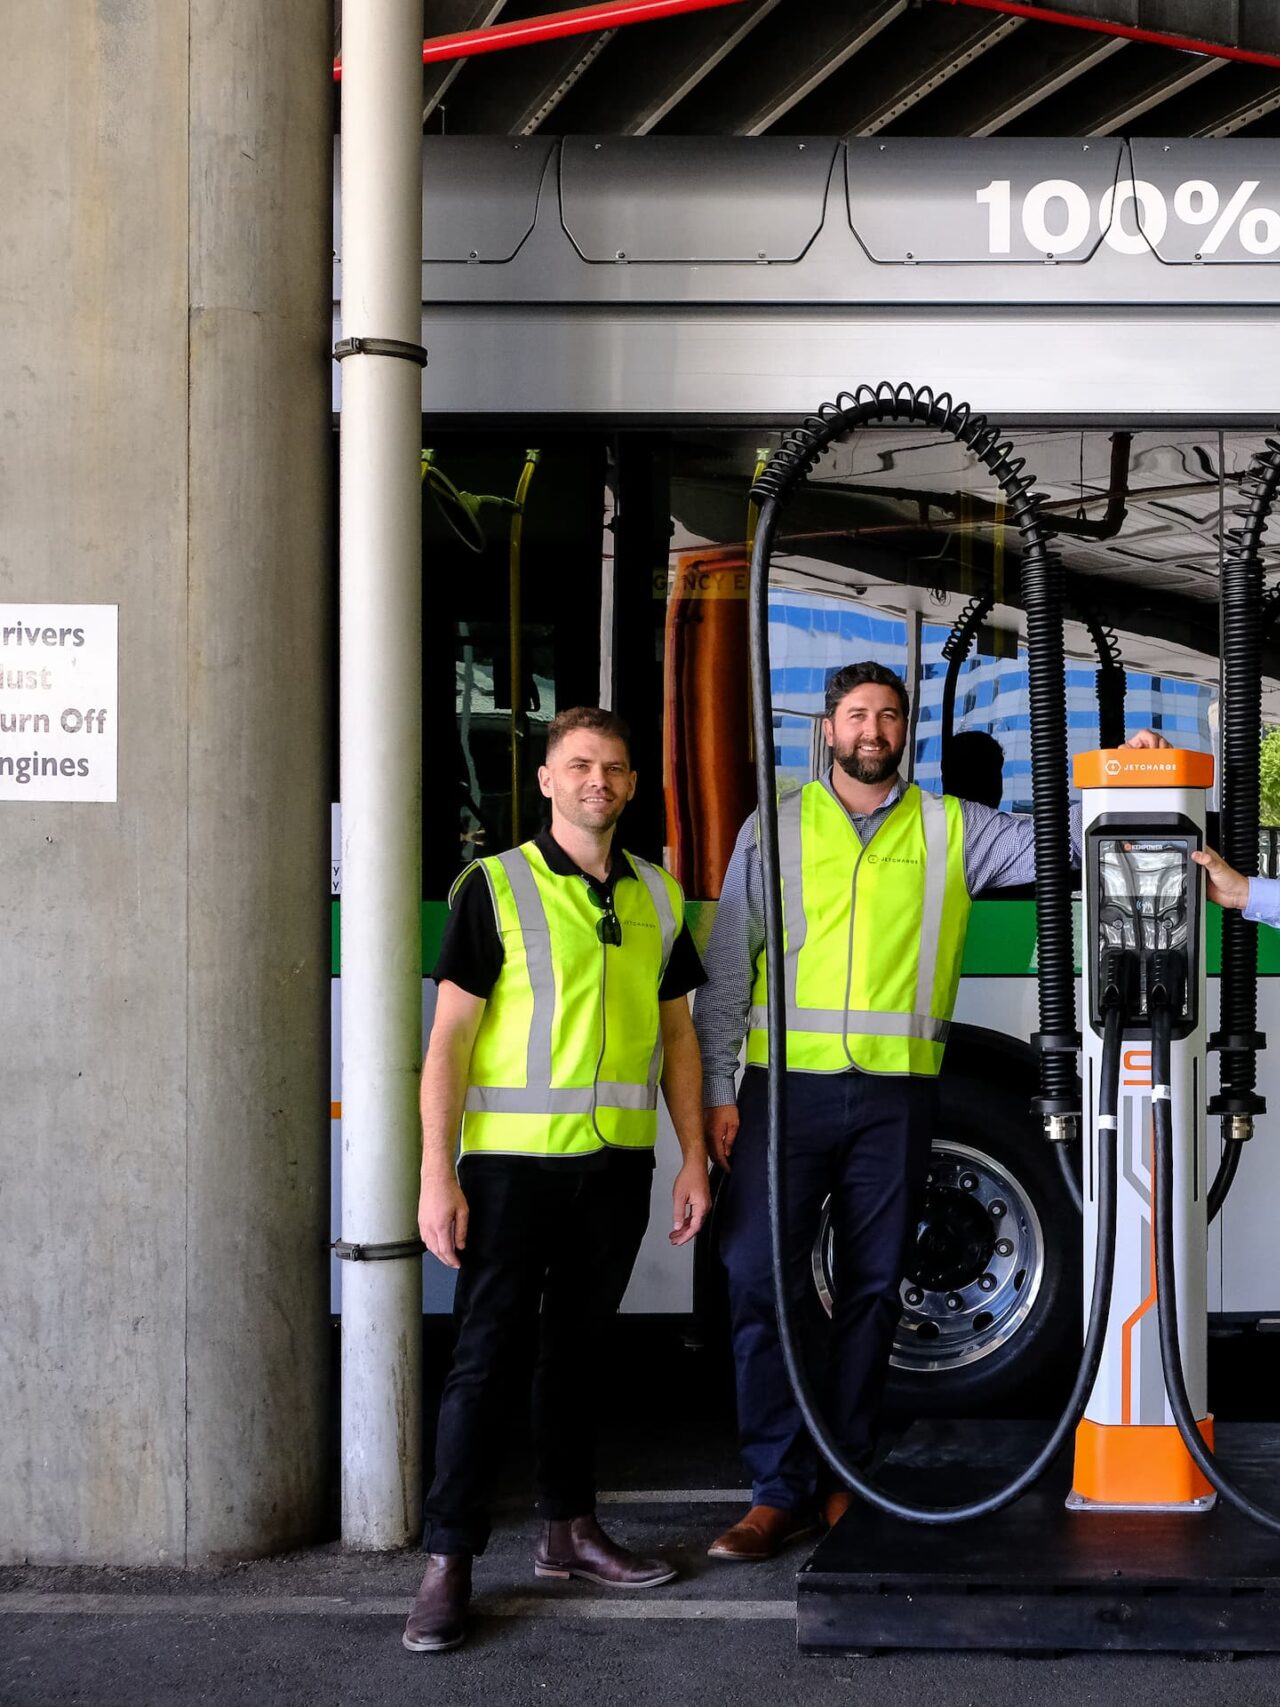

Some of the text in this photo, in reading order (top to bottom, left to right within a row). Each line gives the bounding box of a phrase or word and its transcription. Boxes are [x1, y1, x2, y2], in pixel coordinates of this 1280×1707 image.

[2, 621, 85, 647] rivers
[0, 664, 52, 689] ust
[0, 708, 107, 733] urn Off
[0, 751, 89, 784] ngines
